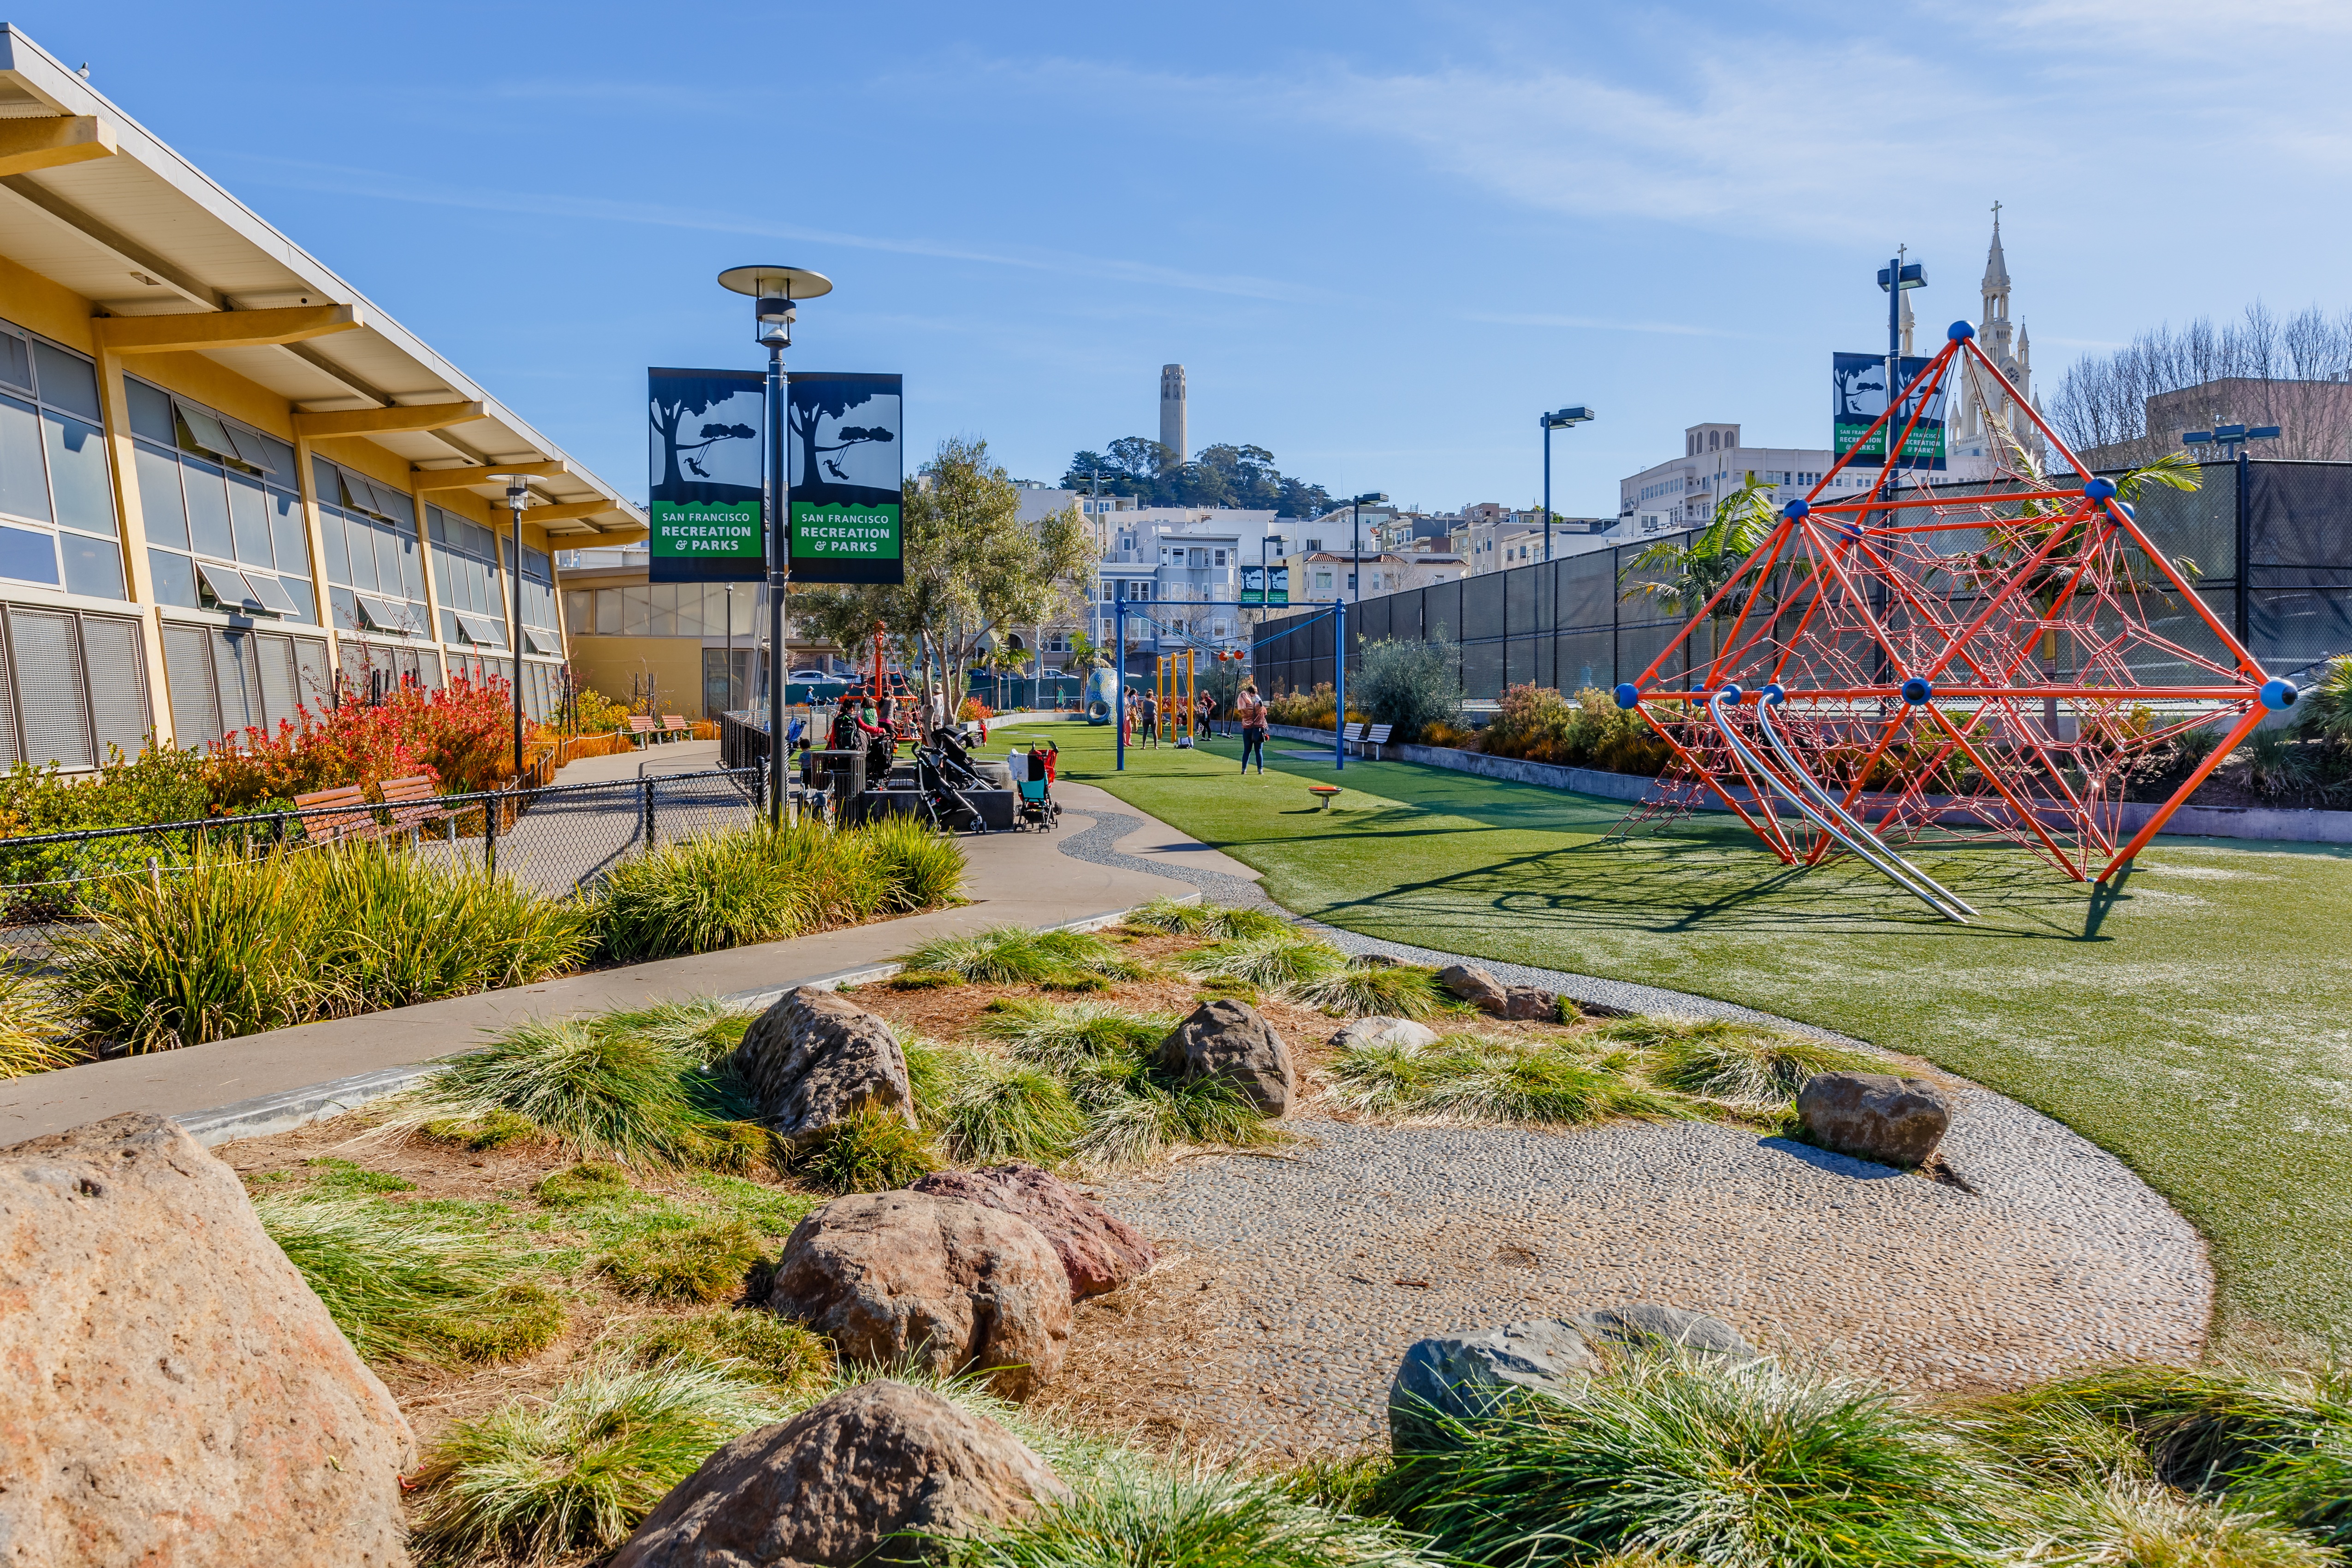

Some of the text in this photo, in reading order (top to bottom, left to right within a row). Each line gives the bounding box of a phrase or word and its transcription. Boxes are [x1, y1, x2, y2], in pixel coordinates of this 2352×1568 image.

[662, 513, 749, 522] SAN FRANCISCO
[802, 514, 889, 523] SAN FRANCISCO
[661, 526, 751, 536] RECREATION
[801, 527, 890, 538] RECREATION
[675, 540, 739, 550] & PARKS
[814, 541, 877, 552] & PARKS
